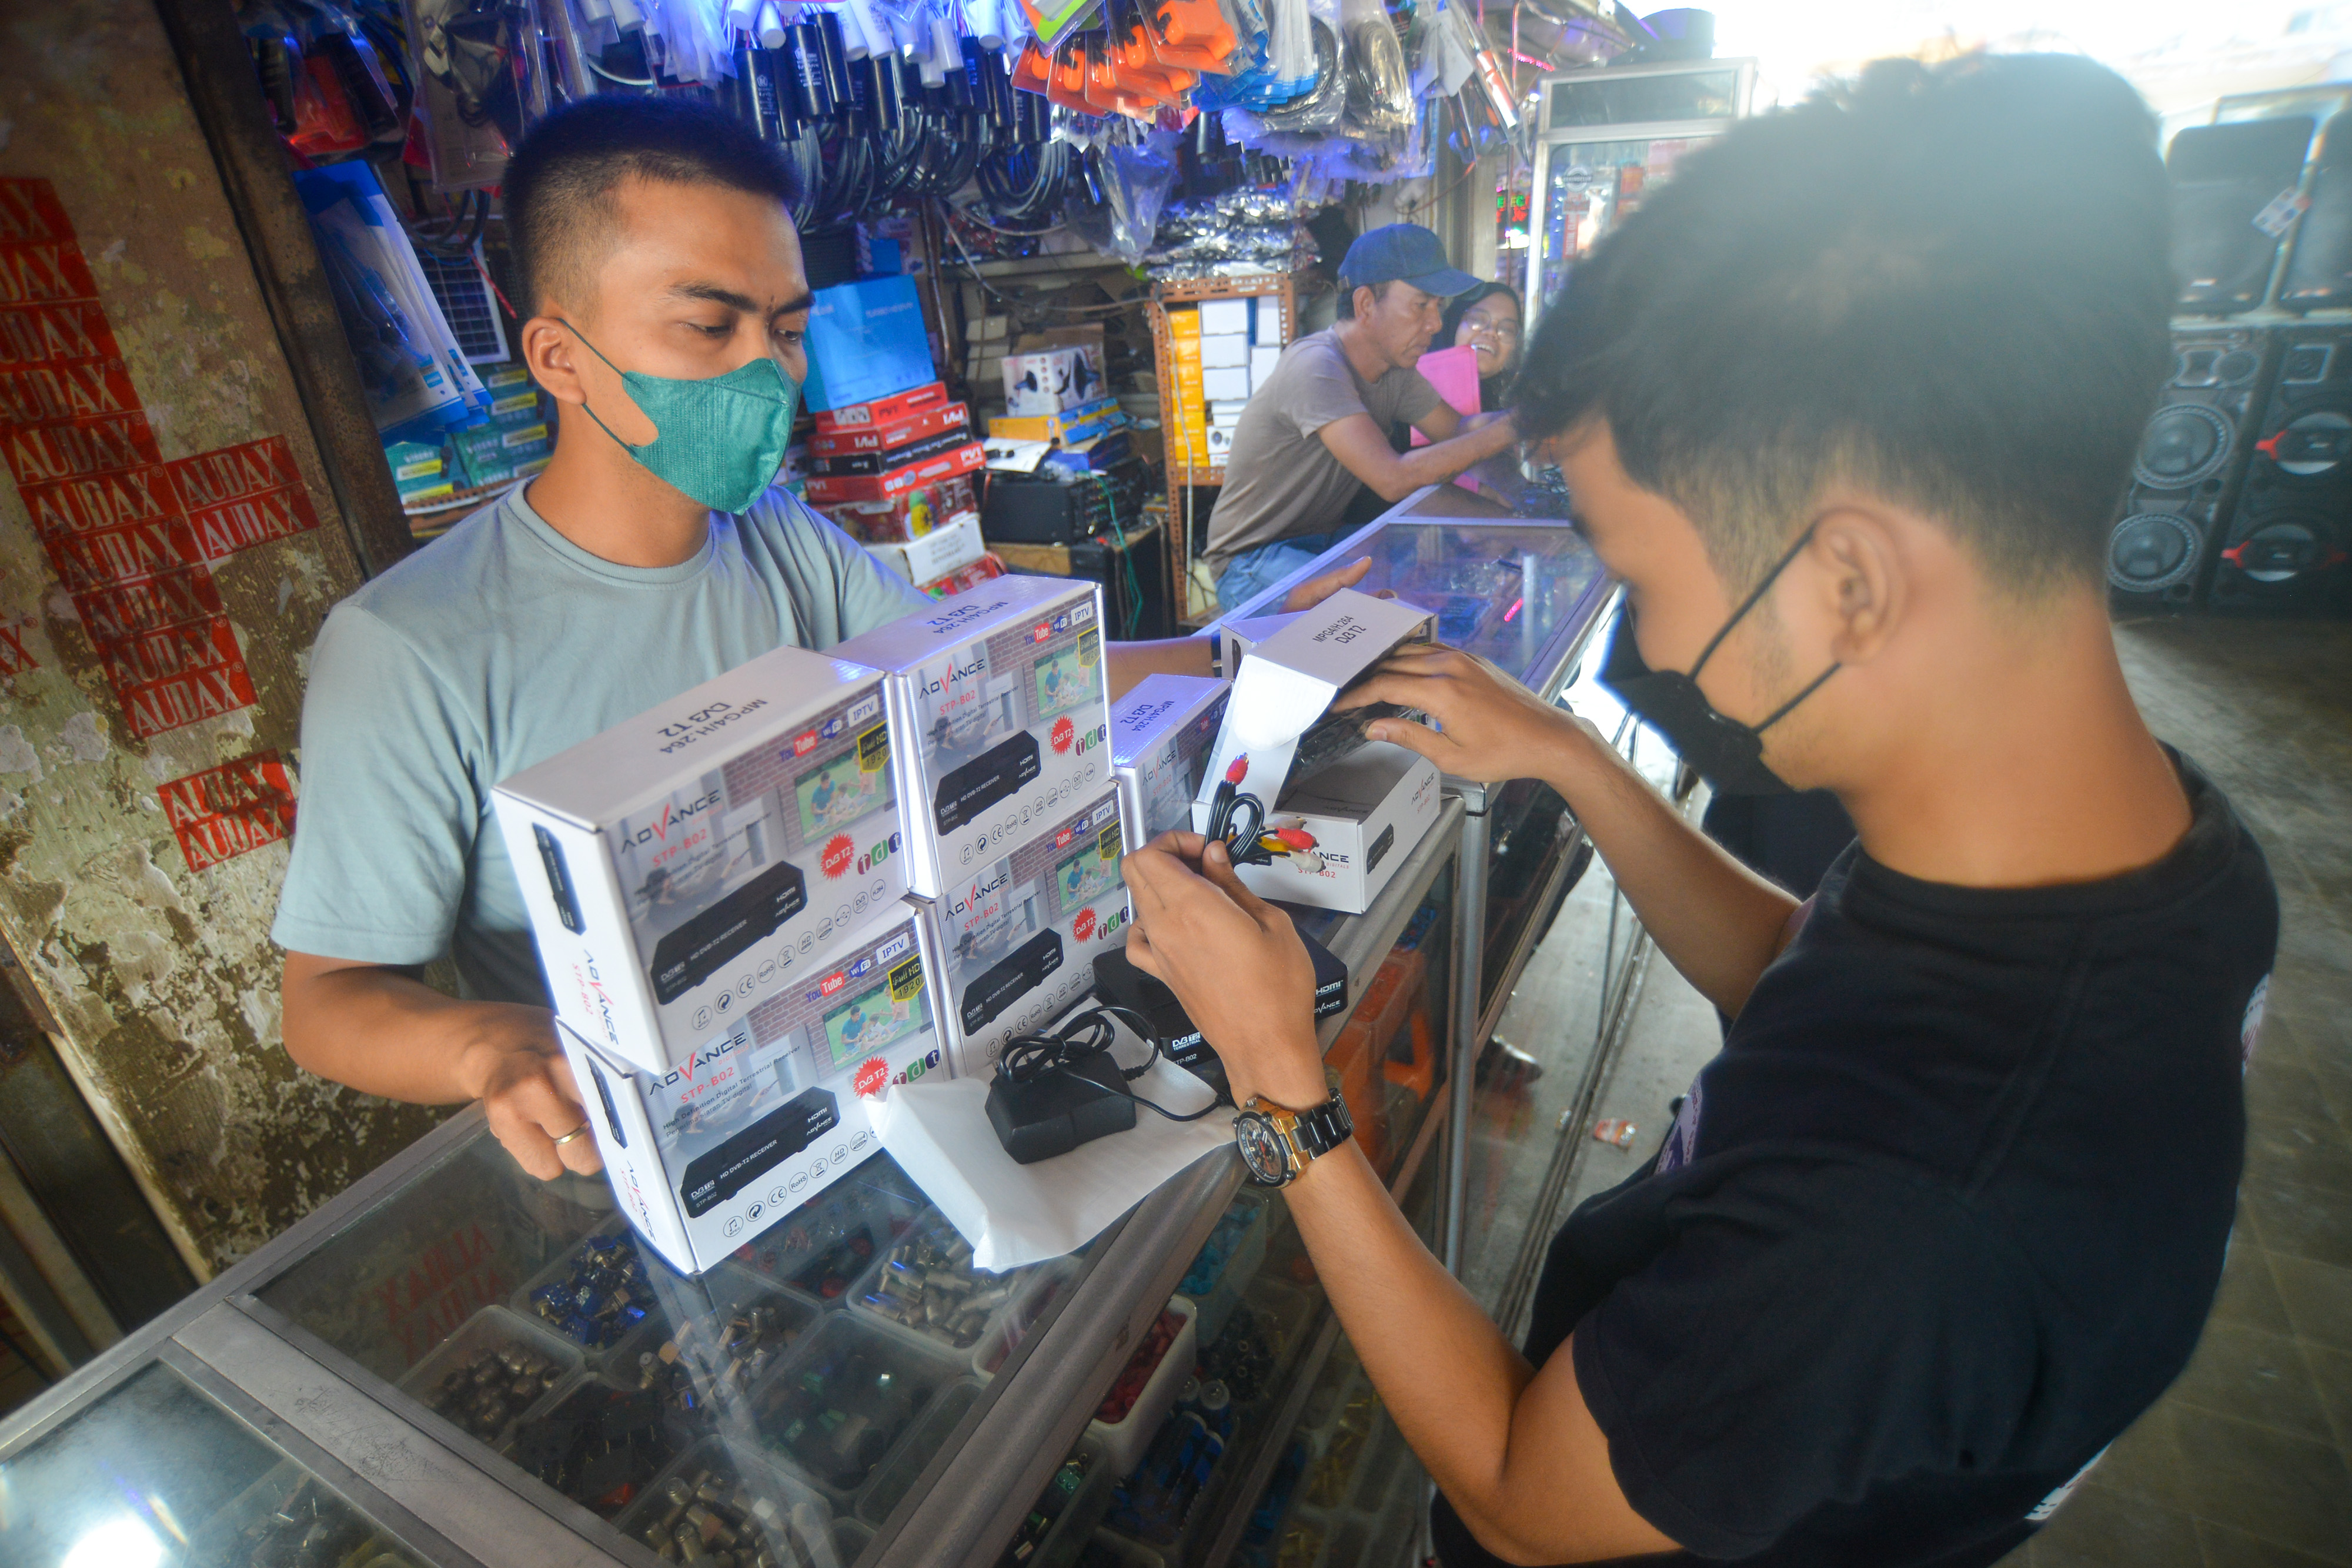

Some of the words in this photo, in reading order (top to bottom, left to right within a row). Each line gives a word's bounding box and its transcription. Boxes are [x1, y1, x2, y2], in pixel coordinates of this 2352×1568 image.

[12, 418, 147, 482] AUDAX
[179, 443, 286, 509] AUDAX
[37, 472, 165, 536] AUDAX
[202, 489, 305, 558] AUDAX
[59, 521, 183, 589] AUDAX
[927, 617, 954, 626] T2
[1074, 606, 1090, 621] IPTV
[1312, 615, 1354, 643] MPG4/H.264
[1334, 633, 1357, 644] DVB
[1348, 624, 1367, 637] T2
[1083, 648, 1098, 662] 1920
[919, 658, 985, 700] ADVANCE
[130, 668, 245, 737] AUDAX
[687, 702, 733, 723] DVB
[853, 701, 874, 721] IPTV
[940, 689, 976, 716] STP-B02
[1131, 704, 1154, 717] DVB
[656, 723, 694, 737] T2
[1120, 716, 1140, 724] T2
[1054, 733, 1064, 745] DVB
[1064, 728, 1073, 738] T2
[866, 748, 887, 767] 1920
[1020, 754, 1034, 767] HDMI
[1411, 772, 1435, 805] ADVANCE
[621, 789, 721, 854] ADVANCE
[1095, 804, 1111, 821] IPTV
[188, 799, 290, 870] AUDAX
[652, 828, 708, 868] STP-B02
[825, 854, 841, 869] DVB
[841, 845, 851, 858] T2
[945, 872, 1008, 922] ADVANCE
[964, 902, 999, 932] STP-B02
[986, 917, 1001, 931] Digital
[1000, 902, 1023, 919] Terrestrial
[1075, 924, 1087, 935] DVB
[1086, 917, 1094, 927] T2
[801, 934, 811, 947] HD
[881, 939, 905, 959] IPTV
[759, 963, 775, 979] RoHS
[892, 969, 908, 986] Full
[907, 962, 921, 977] HD
[898, 978, 921, 997] 1920
[1315, 980, 1342, 996] HDMI
[1314, 1000, 1341, 1014] DVANCE
[1172, 1035, 1188, 1048] DVB
[1188, 1031, 1201, 1042] T2
[1173, 1038, 1201, 1051] TERRESTRIAL
[649, 1031, 747, 1096] ADVANCE
[718, 1044, 749, 1066] DIGITALS
[680, 1066, 735, 1104] STP-B02
[858, 1075, 875, 1089] DVB
[874, 1066, 886, 1080] T2
[663, 1116, 680, 1131] High
[681, 1096, 716, 1121] Definition
[716, 1081, 739, 1102] Digital
[739, 1062, 773, 1085] Terrestrial
[773, 1045, 801, 1065] Receiver
[721, 1095, 732, 1105] TV
[731, 1084, 753, 1102] digital
[807, 1106, 828, 1124] HDMI
[806, 1116, 833, 1136] ADVANCE
[720, 1170, 730, 1180] HD
[729, 1157, 750, 1175] DVB-T2
[750, 1139, 778, 1161] RECEIVER
[834, 1147, 845, 1159] HD
[690, 1185, 704, 1199] DVB
[790, 1175, 807, 1190] RoHS
